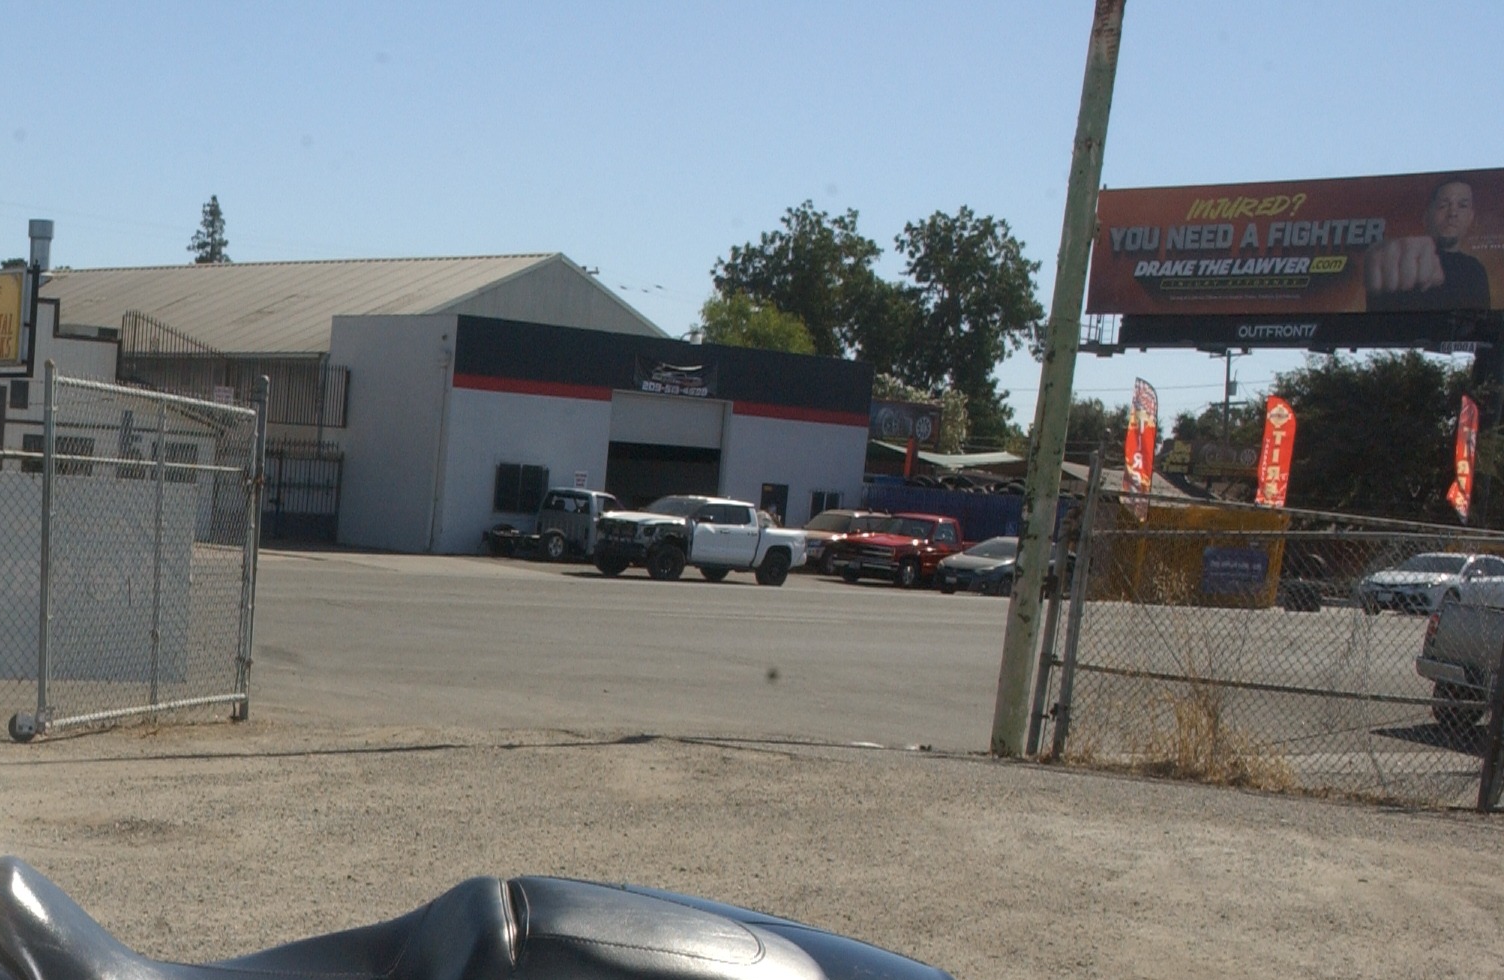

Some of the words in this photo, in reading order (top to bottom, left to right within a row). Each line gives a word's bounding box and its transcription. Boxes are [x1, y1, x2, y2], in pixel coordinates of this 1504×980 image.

[1186, 193, 1307, 221] INJURED?
[1110, 226, 1160, 251] YOU
[1166, 224, 1234, 250] NEED
[1239, 222, 1259, 248] A
[1267, 218, 1386, 248] FIGHTER
[1134, 259, 1196, 277] DRAKE
[1197, 258, 1234, 275] THE
[1231, 256, 1311, 275] LAWYER
